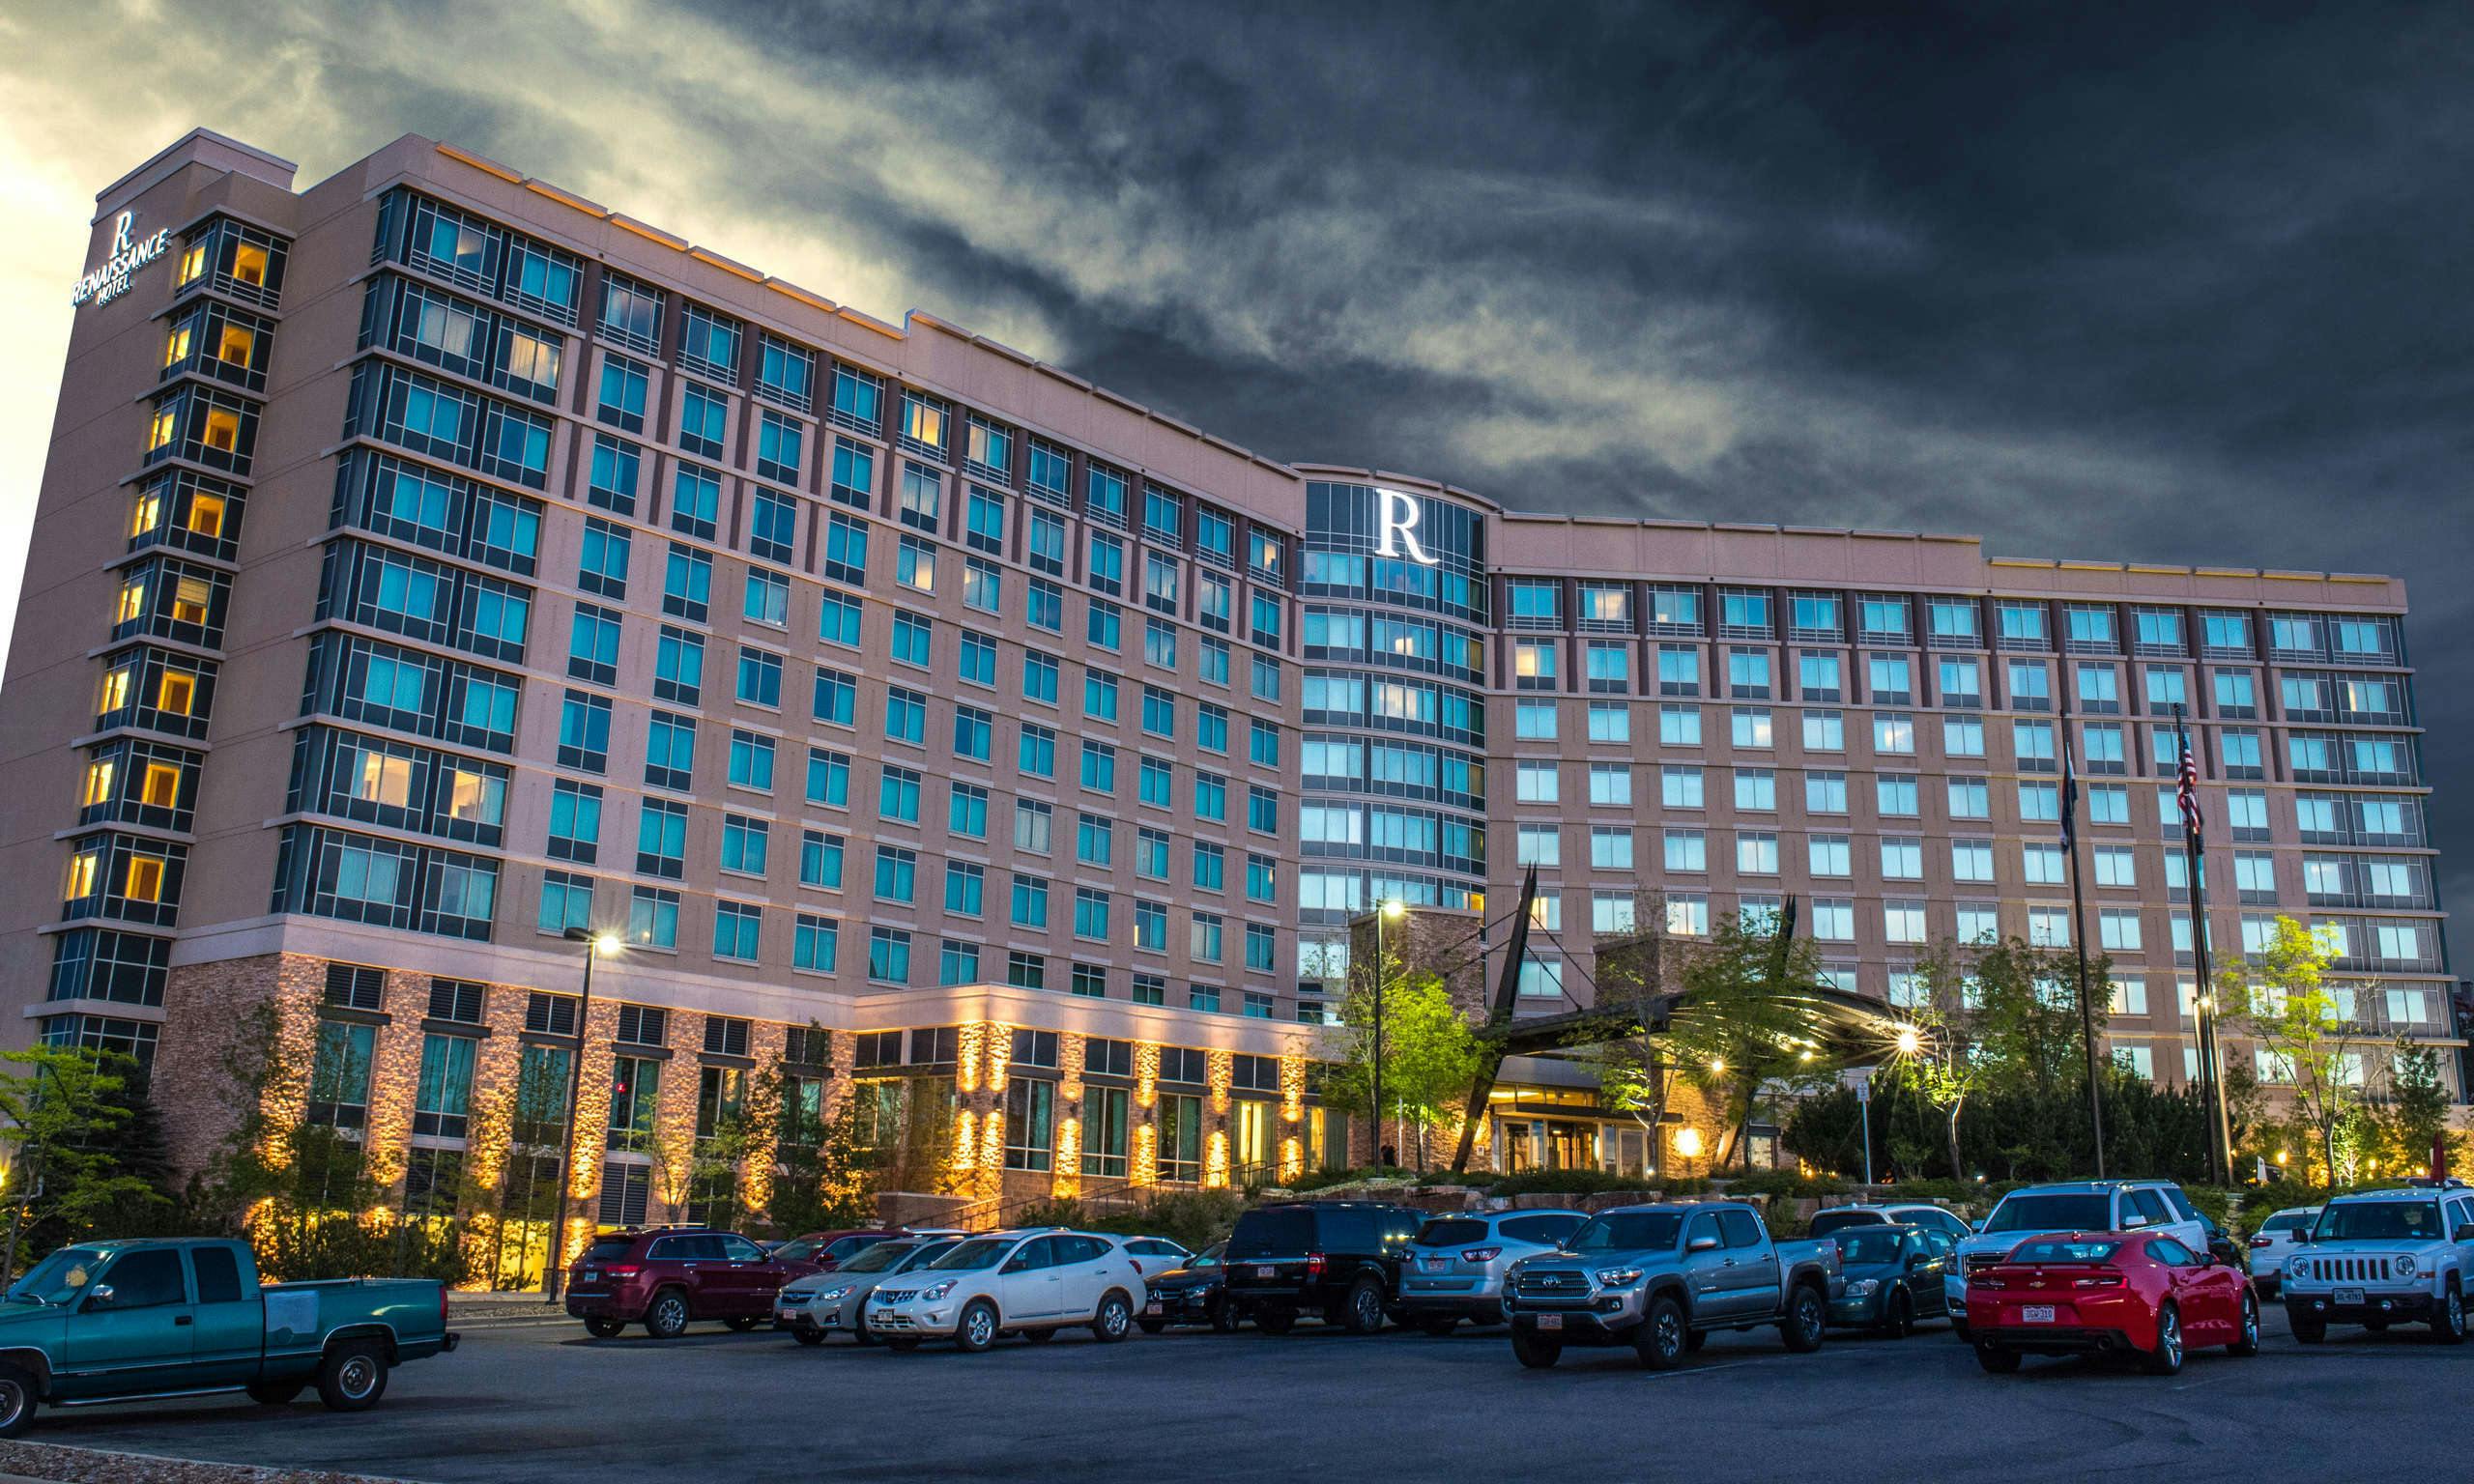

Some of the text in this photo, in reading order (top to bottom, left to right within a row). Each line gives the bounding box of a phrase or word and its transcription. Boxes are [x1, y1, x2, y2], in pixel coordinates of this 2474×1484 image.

[108, 211, 133, 260] R
[72, 228, 170, 306] RENAISSANCE
[97, 273, 131, 306] HOTEL
[1374, 488, 1439, 564] R
